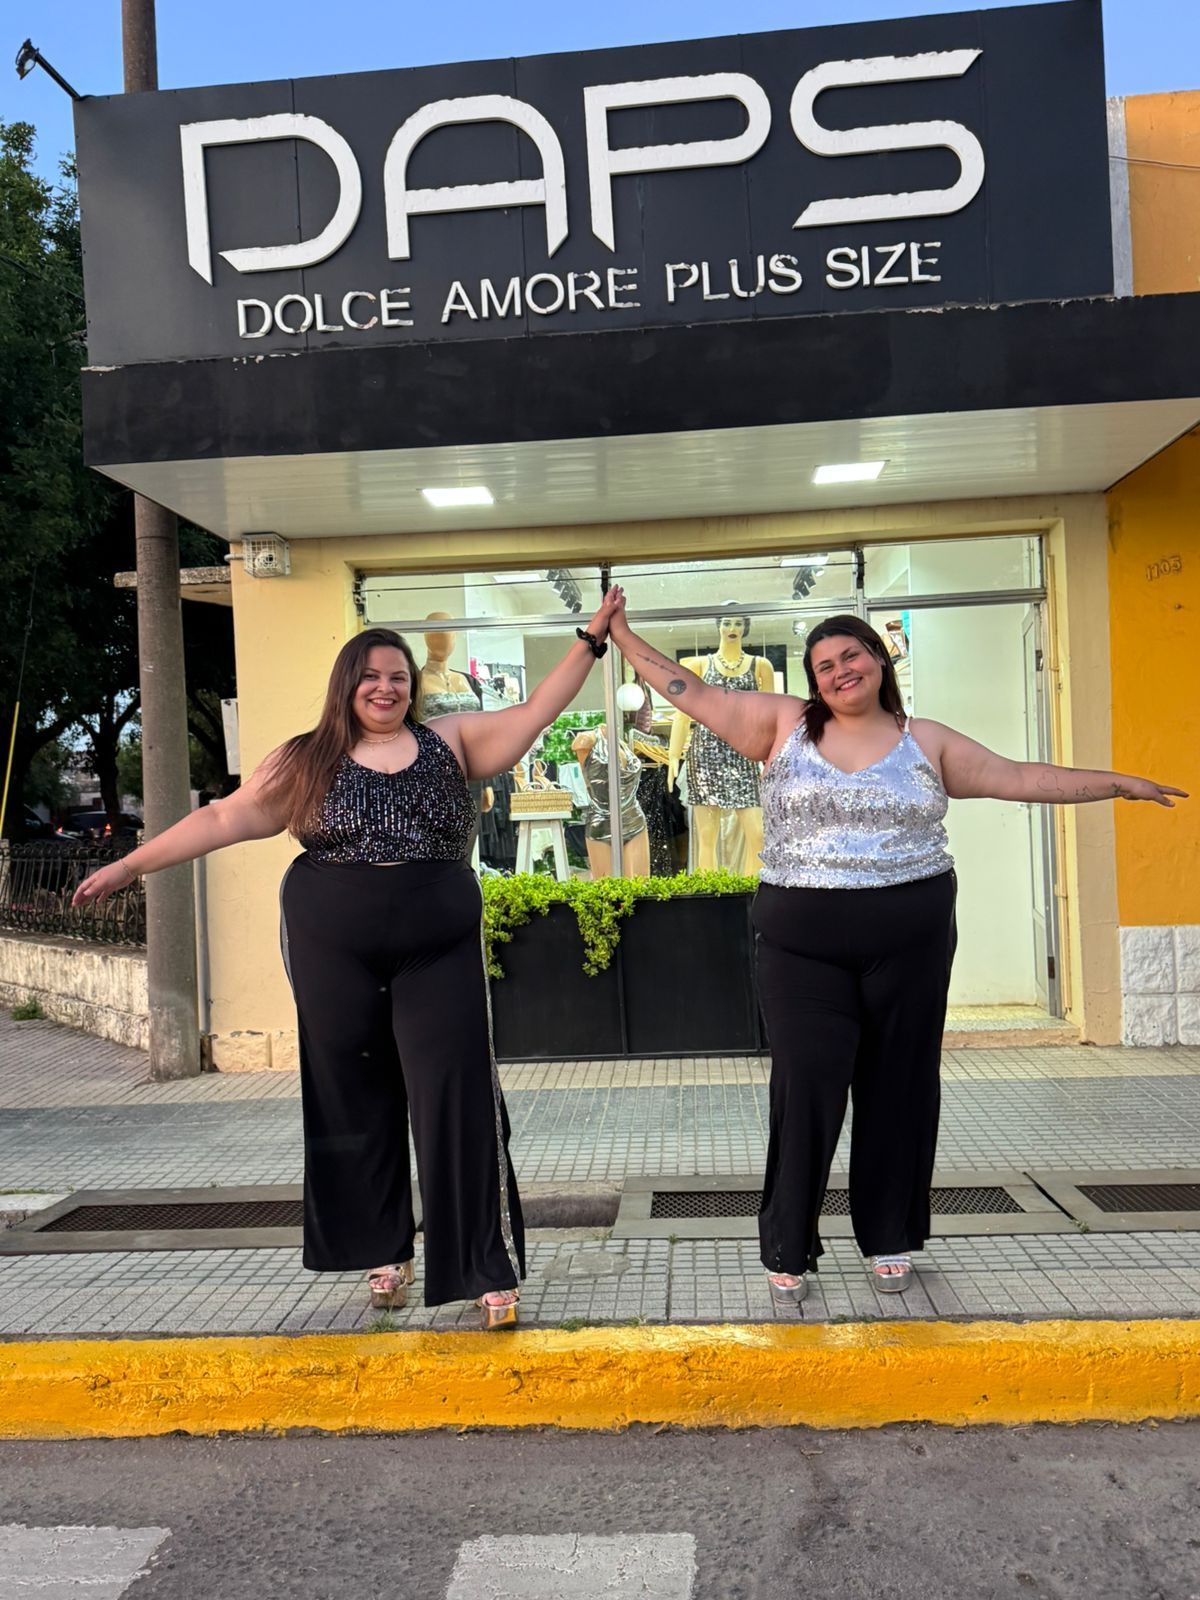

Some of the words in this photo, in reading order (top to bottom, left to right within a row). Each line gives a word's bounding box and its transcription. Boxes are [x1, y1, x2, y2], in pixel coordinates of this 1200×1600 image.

[180, 48, 986, 285] DAPS
[236, 287, 414, 340] DOLCE
[440, 266, 641, 325] AMORE
[665, 253, 803, 303] PLUS
[825, 241, 942, 290] SIZE
